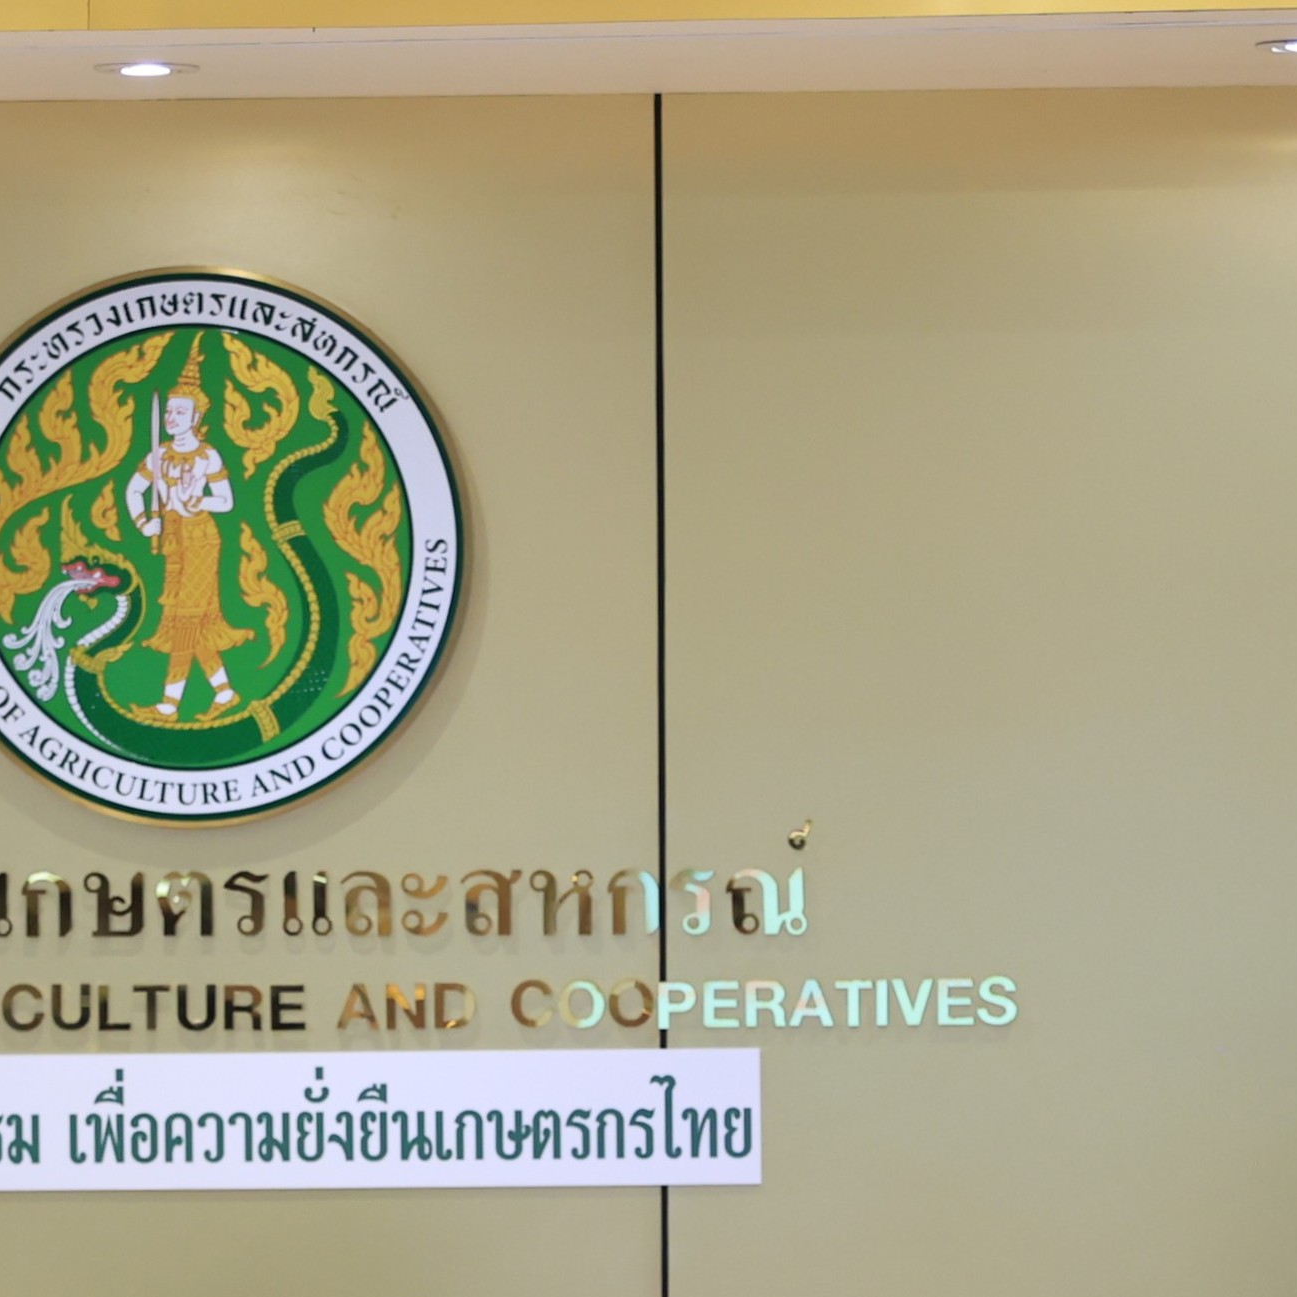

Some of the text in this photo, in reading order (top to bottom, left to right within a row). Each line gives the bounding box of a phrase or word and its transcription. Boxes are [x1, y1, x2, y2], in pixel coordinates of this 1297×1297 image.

[18, 723, 242, 807] AGRICULTURE
[250, 753, 318, 797] AND
[321, 538, 450, 762] COOPERATIVES
[336, 982, 477, 1031] AND
[510, 976, 1018, 1031] COOPERATIVES
[69, 1067, 753, 1166] เพื่อความยั่งยืนเกษตรกรไทย
